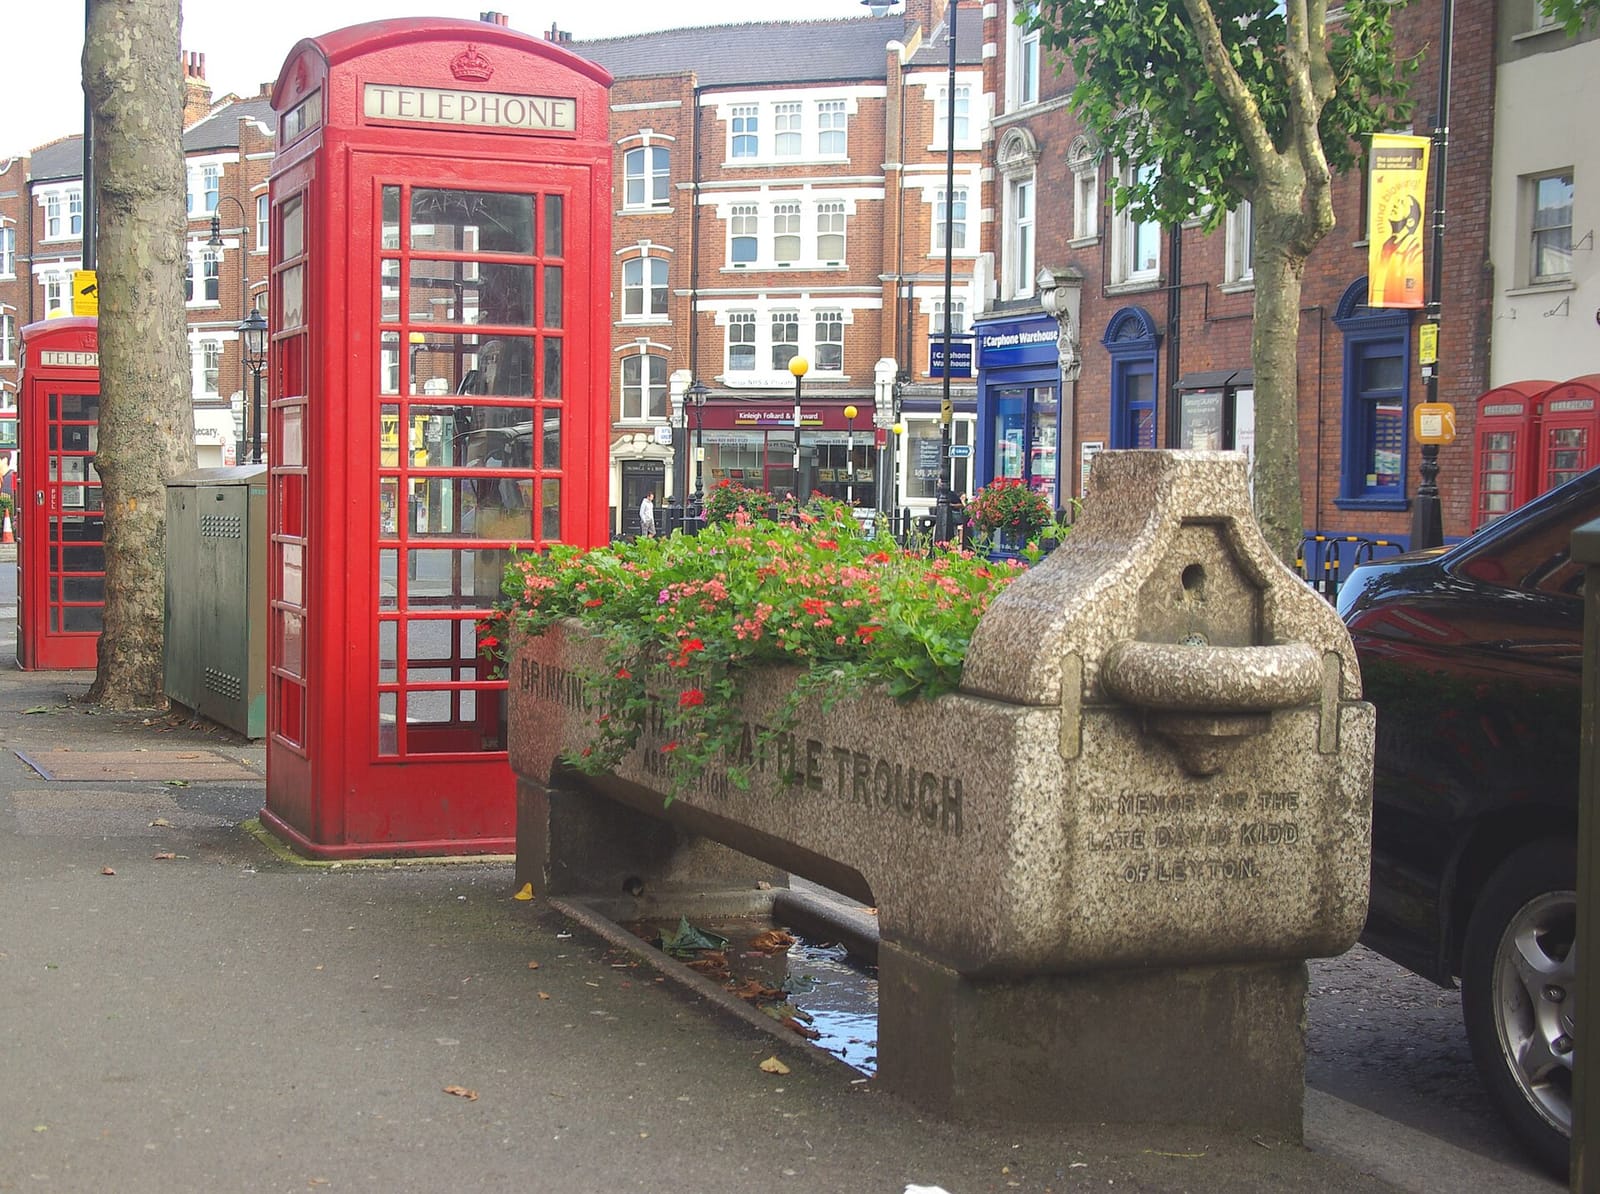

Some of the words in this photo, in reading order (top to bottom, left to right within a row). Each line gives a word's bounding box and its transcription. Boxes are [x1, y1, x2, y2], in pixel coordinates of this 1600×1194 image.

[373, 89, 567, 127] TELEPHONE
[986, 335, 1019, 348] Carphone
[1019, 330, 1058, 342] Warehouse
[936, 351, 971, 360] Caphone
[739, 412, 762, 421] Kinleigh
[763, 412, 785, 420] Folkard
[724, 721, 823, 792] ATTLE
[832, 745, 963, 837] TROUGH
[1089, 795, 1113, 817] IN
[1117, 791, 1207, 817] MEMOR
[1258, 790, 1300, 811] THE
[1087, 829, 1146, 851] LATE
[1155, 825, 1231, 849] DAVID
[1239, 821, 1300, 847] KIDD
[1123, 865, 1150, 884] OF
